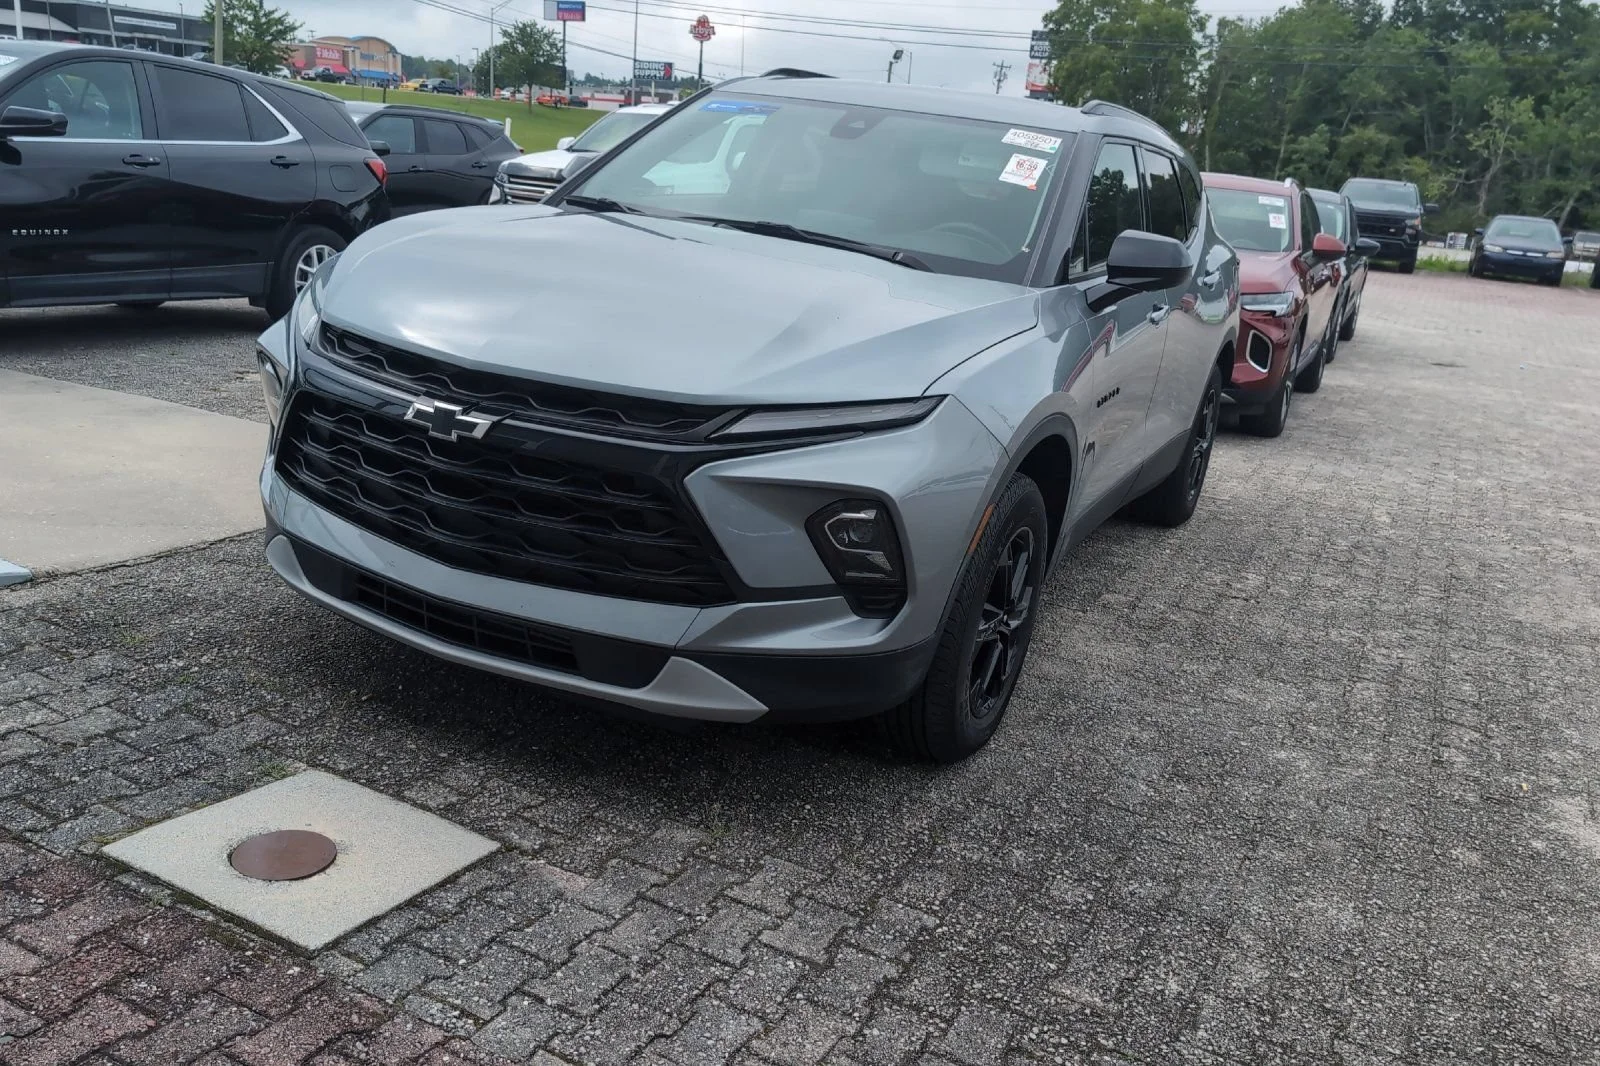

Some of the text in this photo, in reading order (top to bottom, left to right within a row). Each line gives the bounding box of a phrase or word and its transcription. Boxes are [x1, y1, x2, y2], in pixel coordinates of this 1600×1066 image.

[634, 61, 665, 70] SIDING
[634, 69, 665, 77] SUPPLY
[1010, 131, 1058, 146] 4059501
